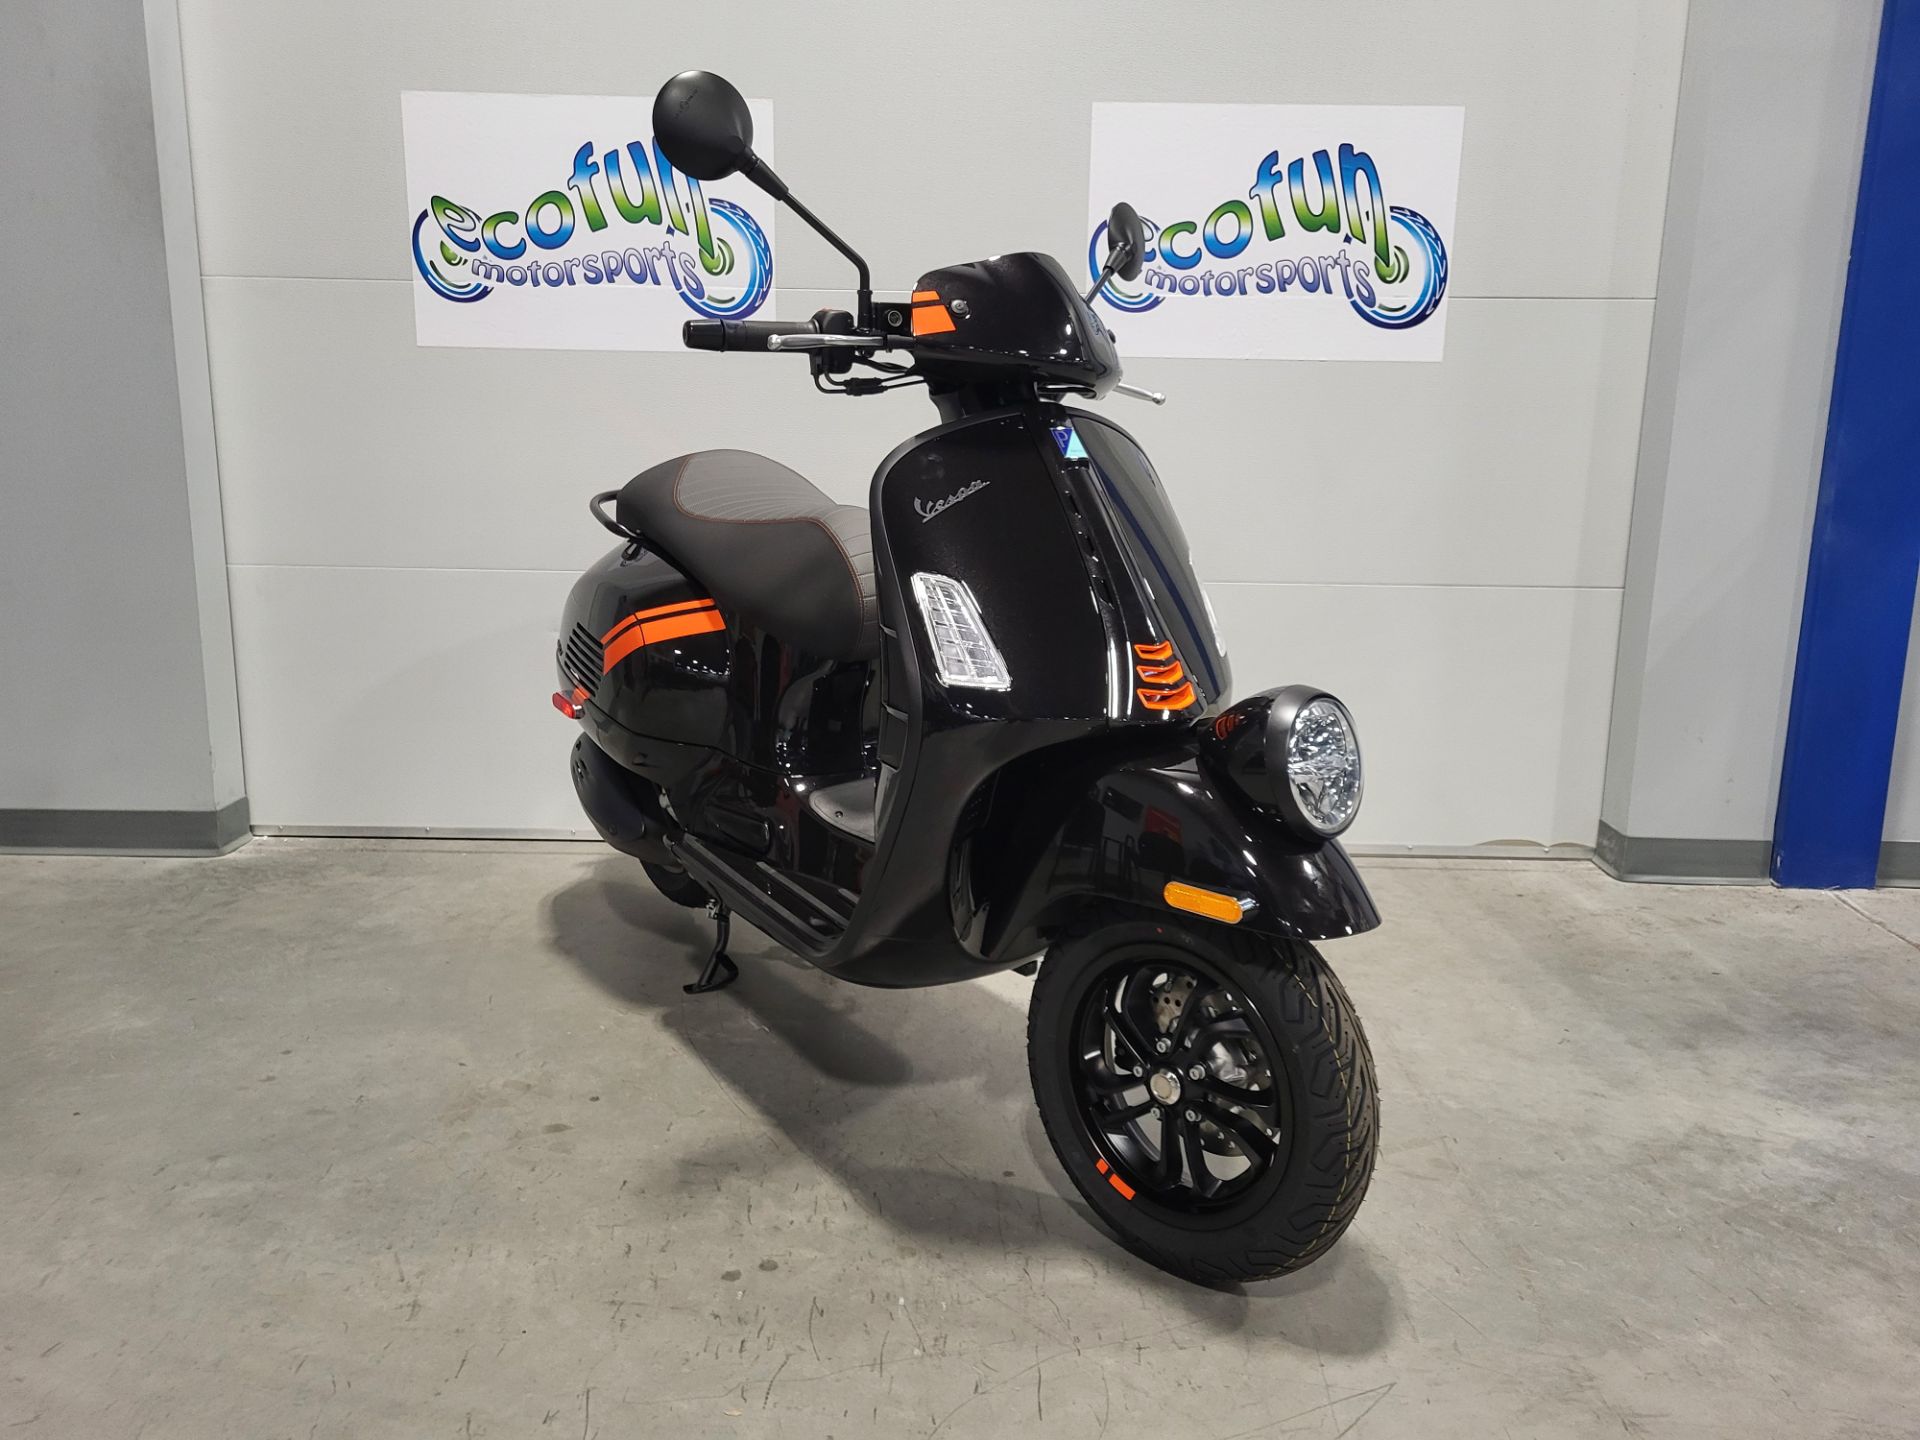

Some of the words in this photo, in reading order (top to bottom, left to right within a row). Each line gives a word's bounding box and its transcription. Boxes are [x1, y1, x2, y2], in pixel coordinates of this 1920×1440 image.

[472, 241, 706, 301] motorsports
[1145, 249, 1376, 308] motorsports
[914, 480, 990, 523] Vespa
